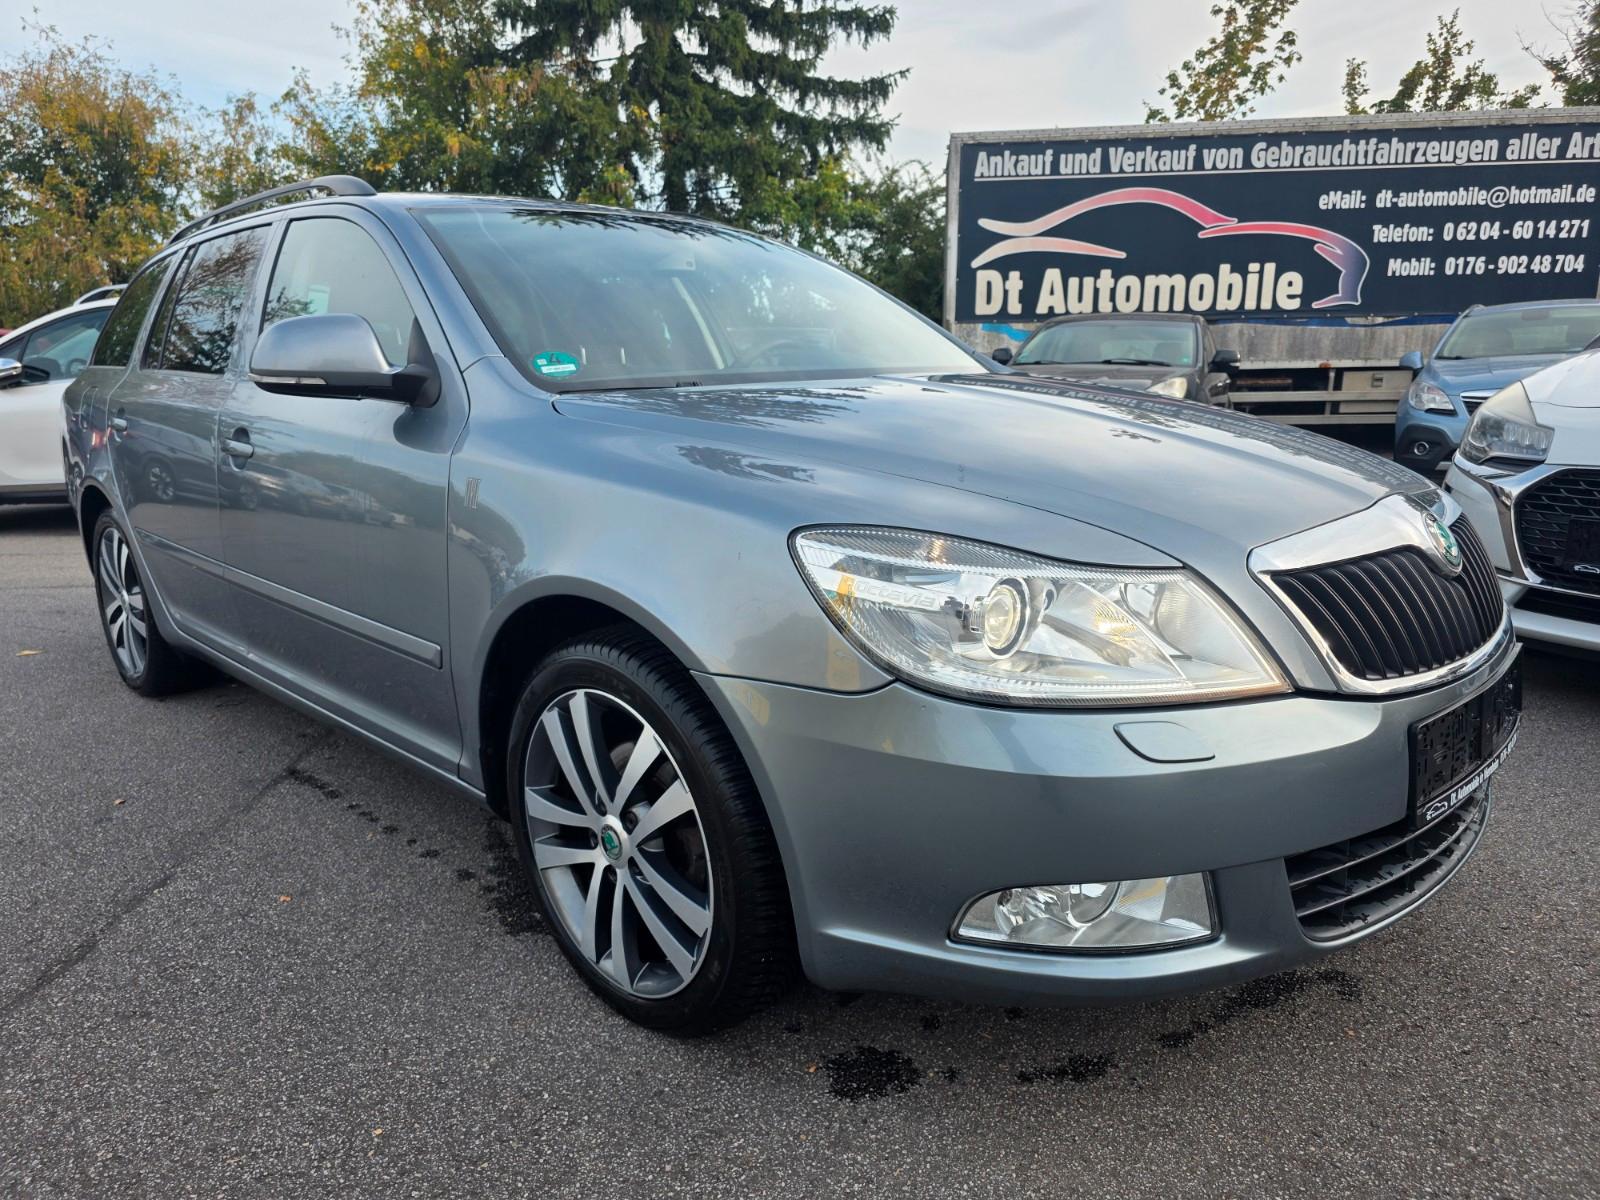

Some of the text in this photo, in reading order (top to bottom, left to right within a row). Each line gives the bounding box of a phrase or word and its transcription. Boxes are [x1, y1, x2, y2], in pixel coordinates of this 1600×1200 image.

[974, 131, 1600, 177] Ankauf und Verkauf von Gebrauchtfahrzeugen aller Art
[1318, 184, 1596, 210] eMail: dt-automobile@hotmail.de
[1372, 224, 1434, 243] Telefon:
[1387, 257, 1436, 276] Mobil:
[974, 262, 1304, 316] Dt Automobile
